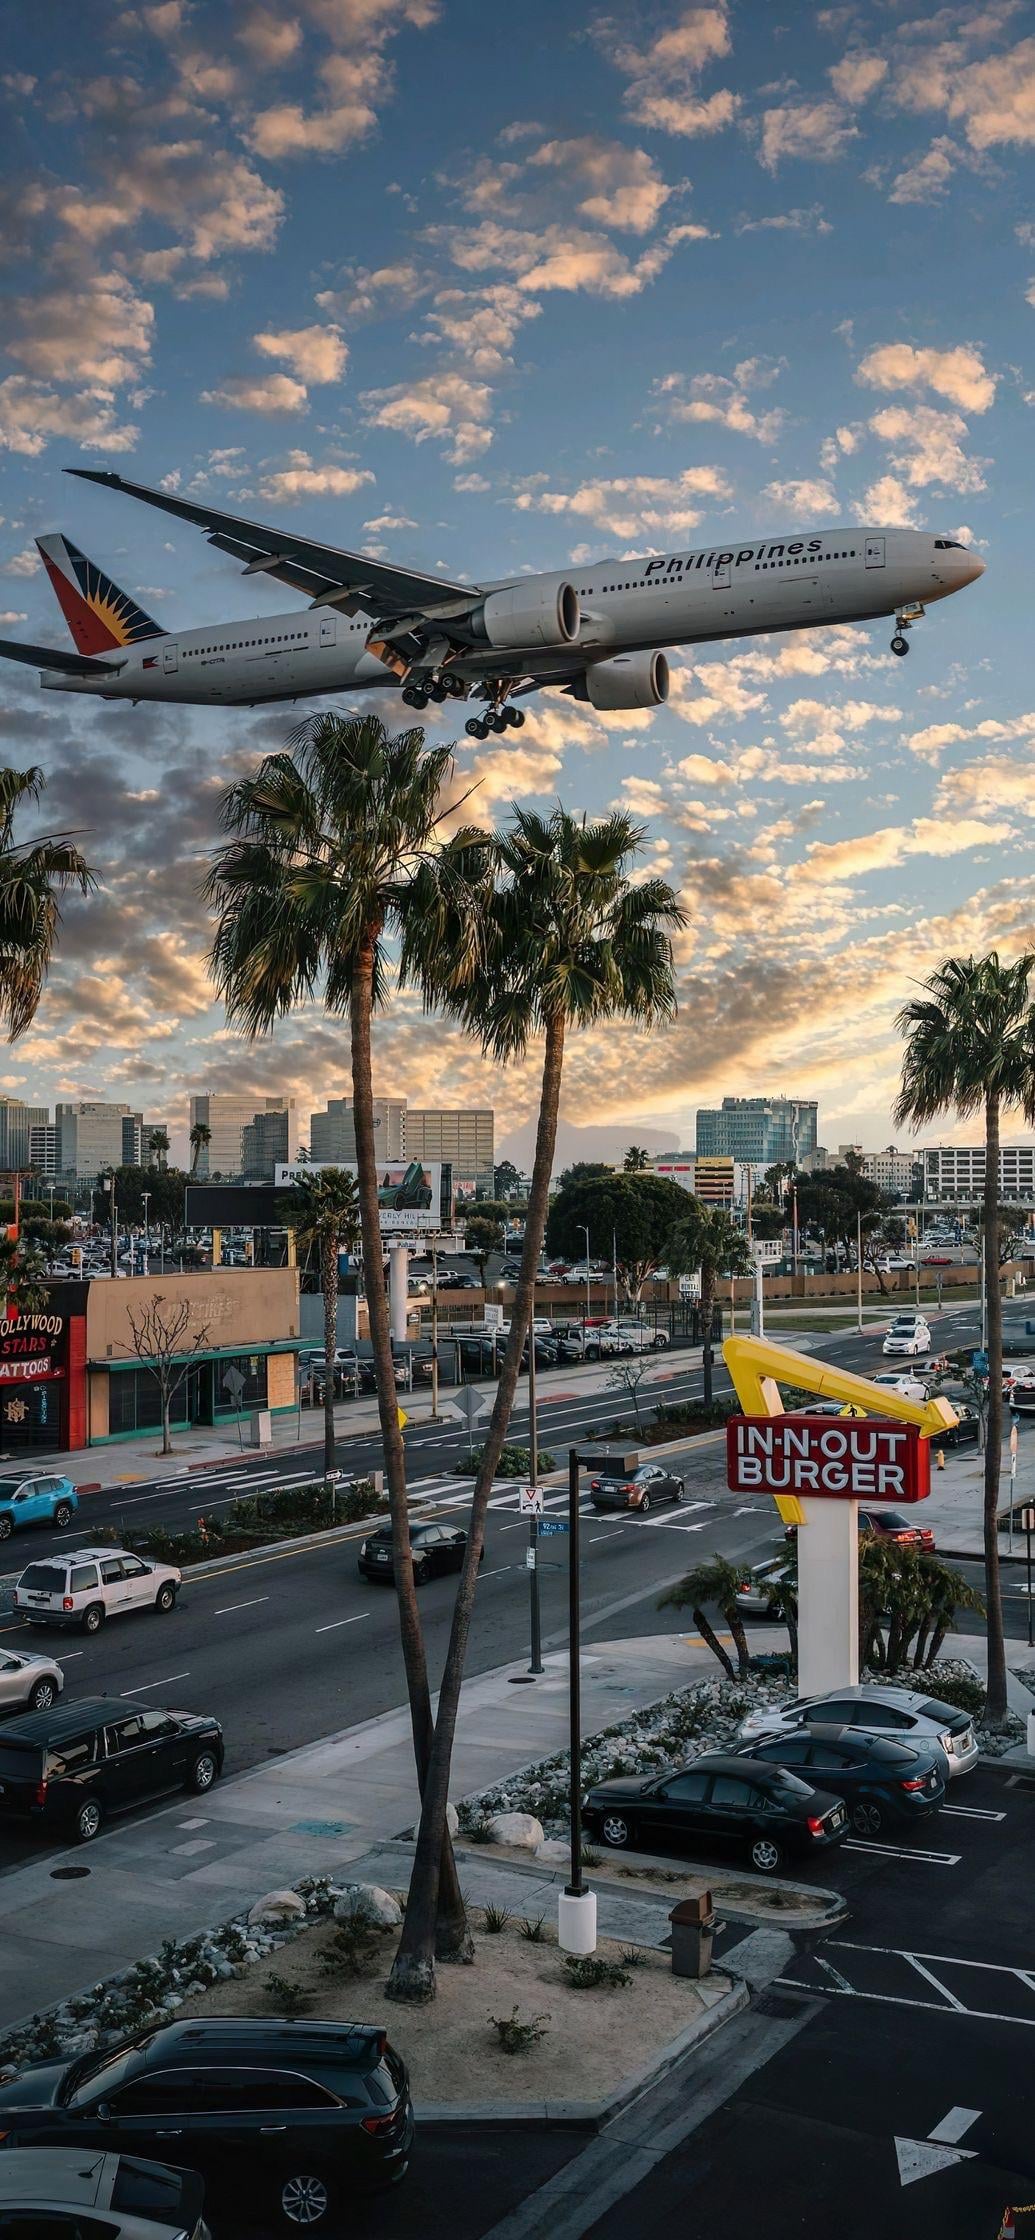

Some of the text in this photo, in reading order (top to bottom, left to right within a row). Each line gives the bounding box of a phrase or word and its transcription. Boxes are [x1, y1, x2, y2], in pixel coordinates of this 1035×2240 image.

[644, 540, 823, 576] Philippines
[0, 1314, 63, 1337] OLLYWOOD
[2, 1337, 47, 1354] STARS
[737, 1425, 907, 1462] IN-N-OUT
[737, 1456, 905, 1494] BURGER
